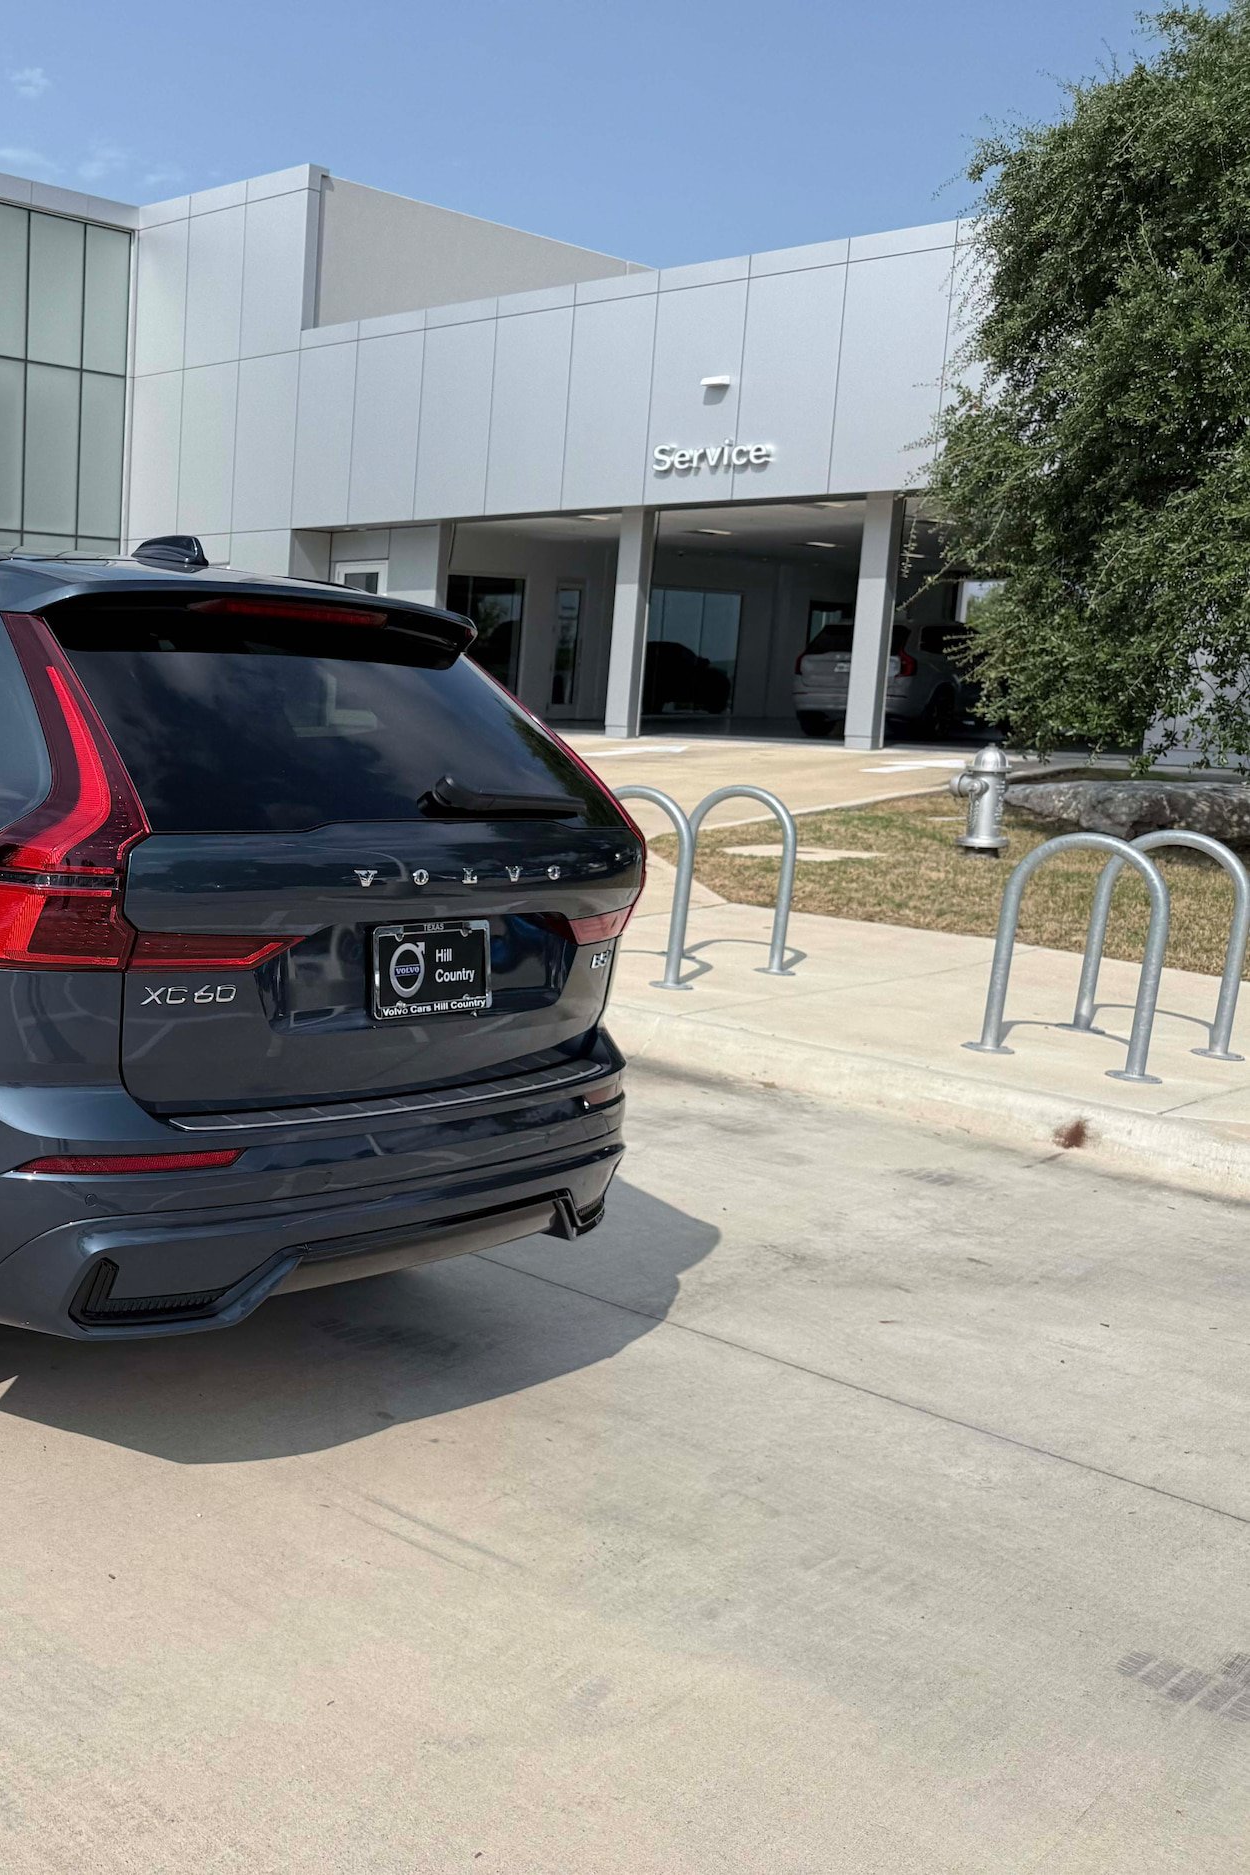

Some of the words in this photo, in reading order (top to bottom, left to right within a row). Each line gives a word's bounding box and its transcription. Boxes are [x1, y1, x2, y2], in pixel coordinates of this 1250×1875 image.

[652, 438, 775, 471] Service
[354, 865, 561, 888] VOLVO
[423, 923, 444, 931] TEXAS
[435, 948, 452, 962] Hill
[395, 966, 420, 974] VOLVO
[435, 968, 475, 982] Country
[382, 1007, 408, 1017] Volvo
[410, 1004, 432, 1013] Cars
[433, 1001, 449, 1011] Hill
[450, 999, 486, 1010] Country
